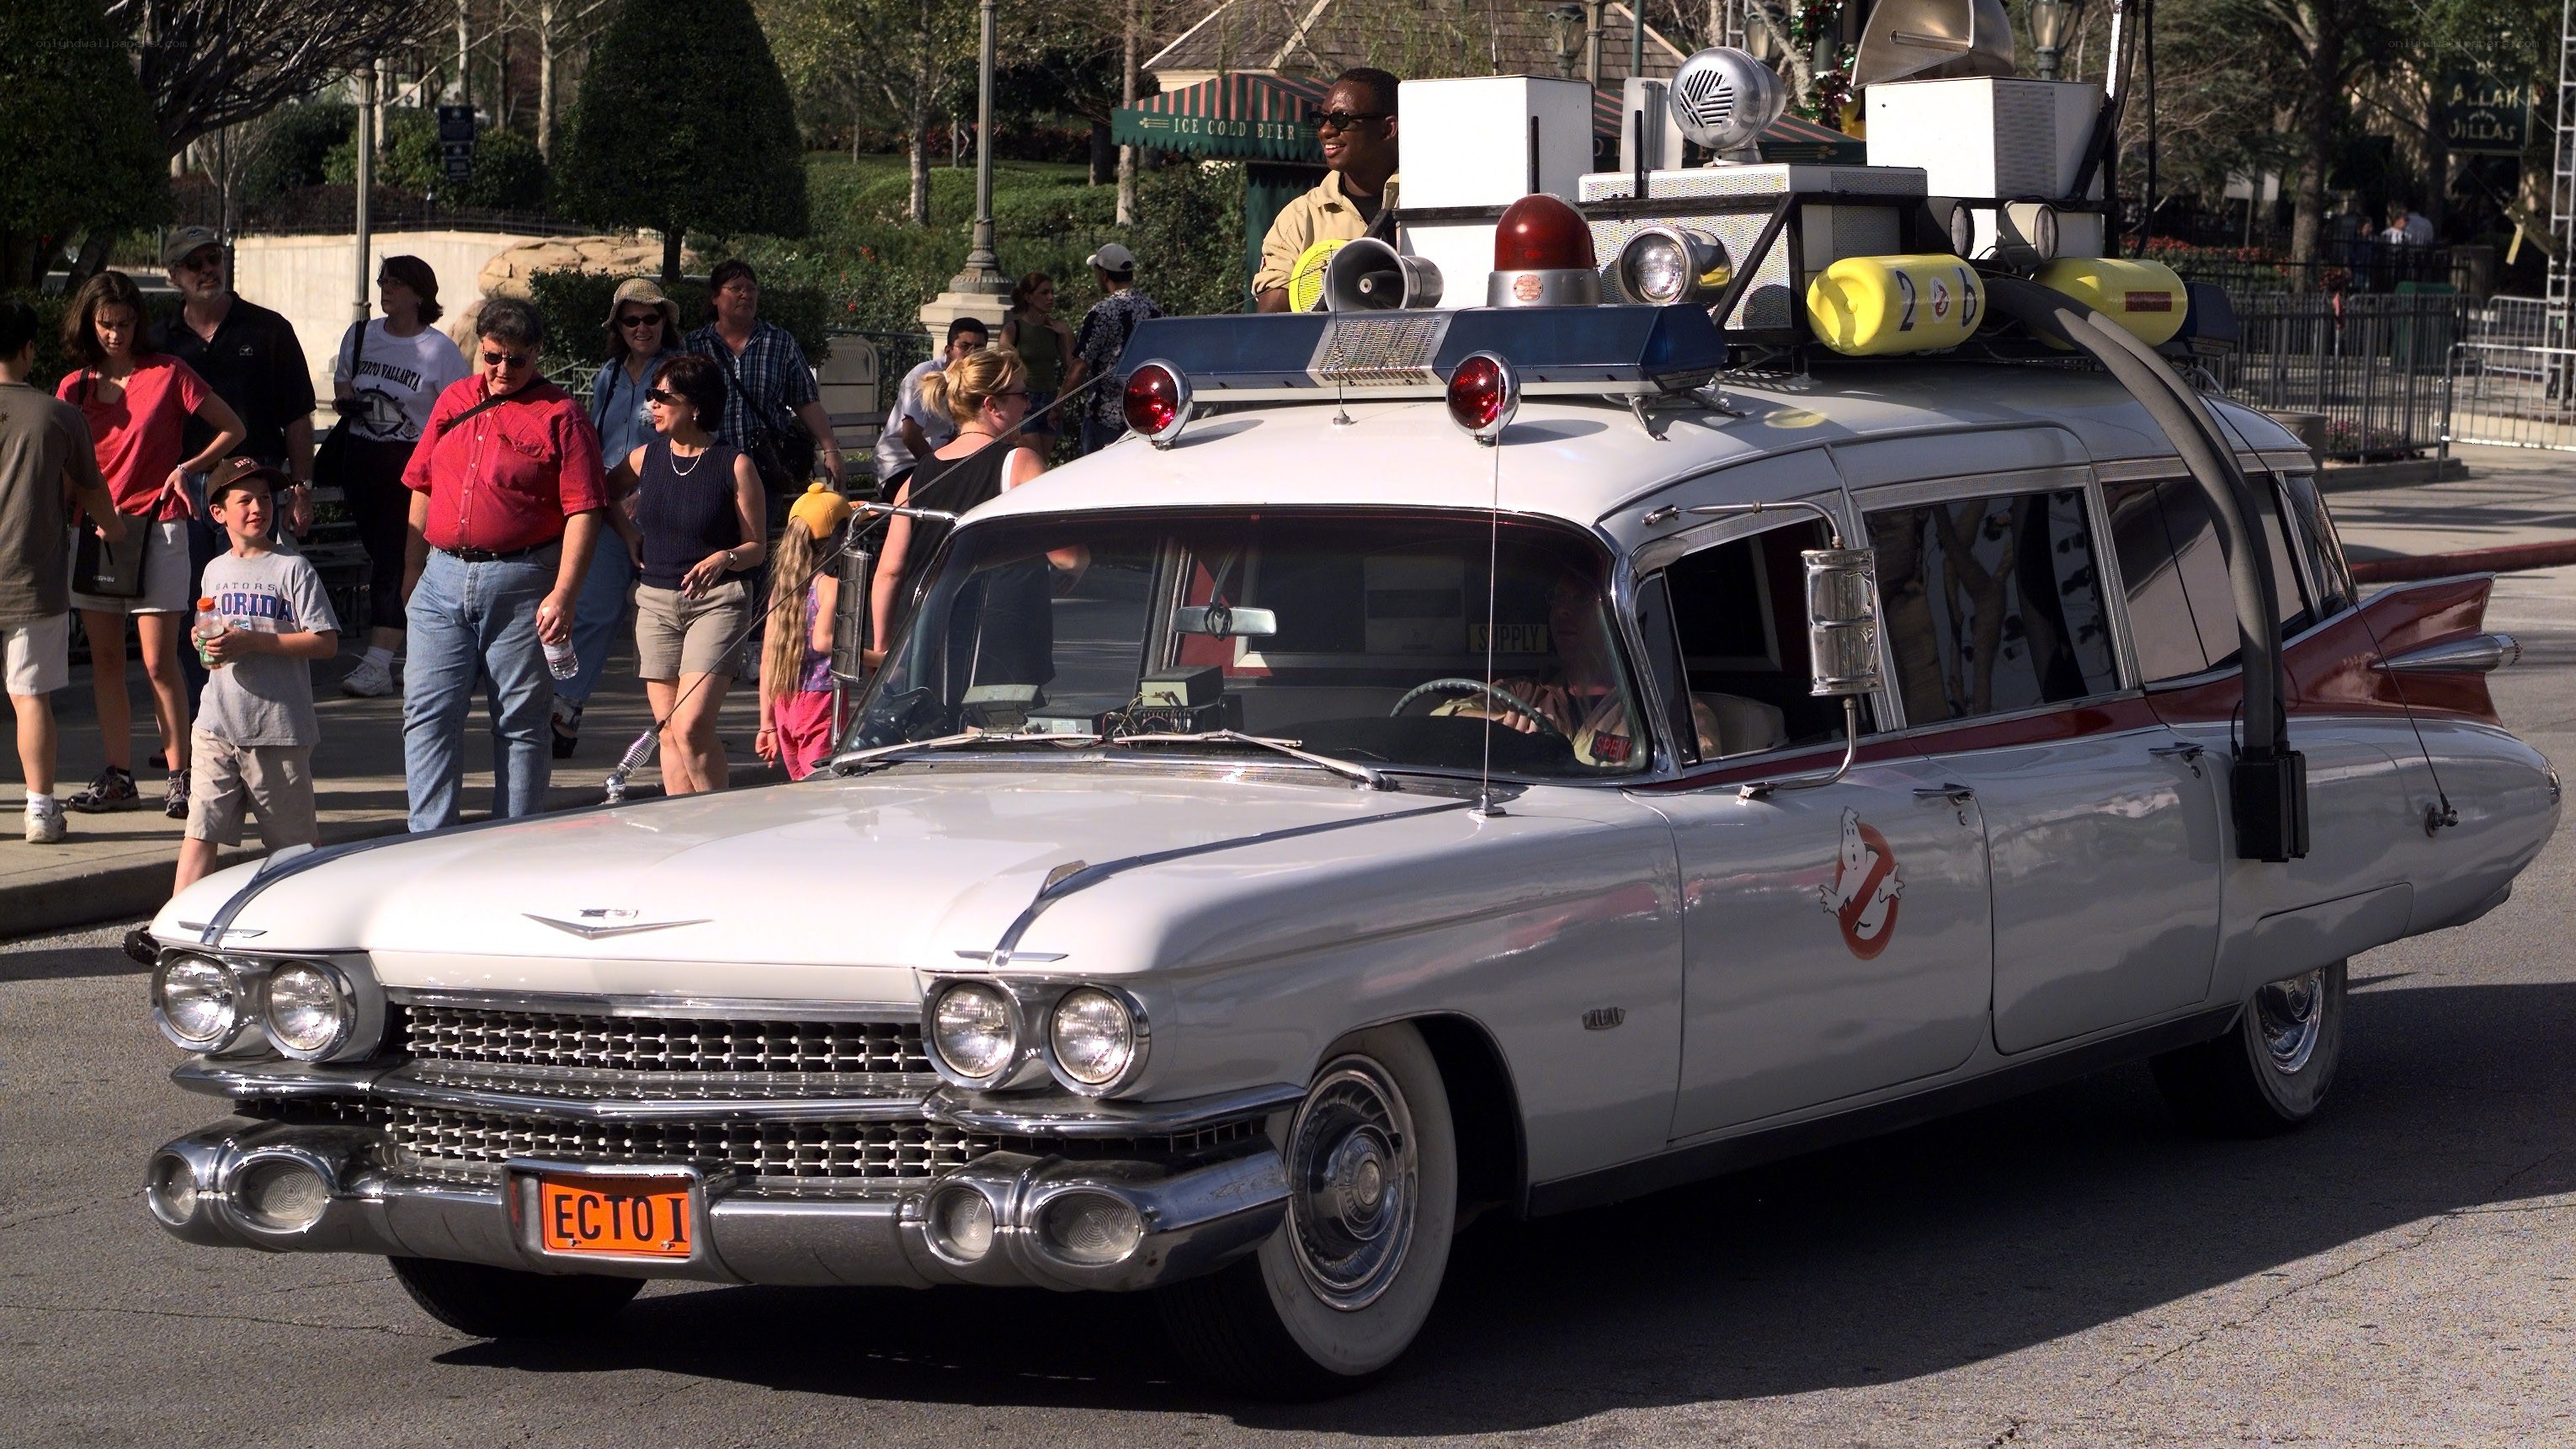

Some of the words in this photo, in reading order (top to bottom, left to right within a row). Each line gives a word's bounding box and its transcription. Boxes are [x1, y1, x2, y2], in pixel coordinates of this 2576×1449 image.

[1174, 117, 1200, 135] ICE
[1207, 120, 1247, 137] COLD
[1257, 123, 1296, 141] BEER
[2447, 117, 2518, 142] VILLAS
[381, 364, 421, 392] VALLARTA
[216, 582, 275, 591] GATORS
[213, 593, 295, 622] ORIDA
[1478, 625, 1540, 651] SUPPLY
[554, 1194, 653, 1242] ECTO
